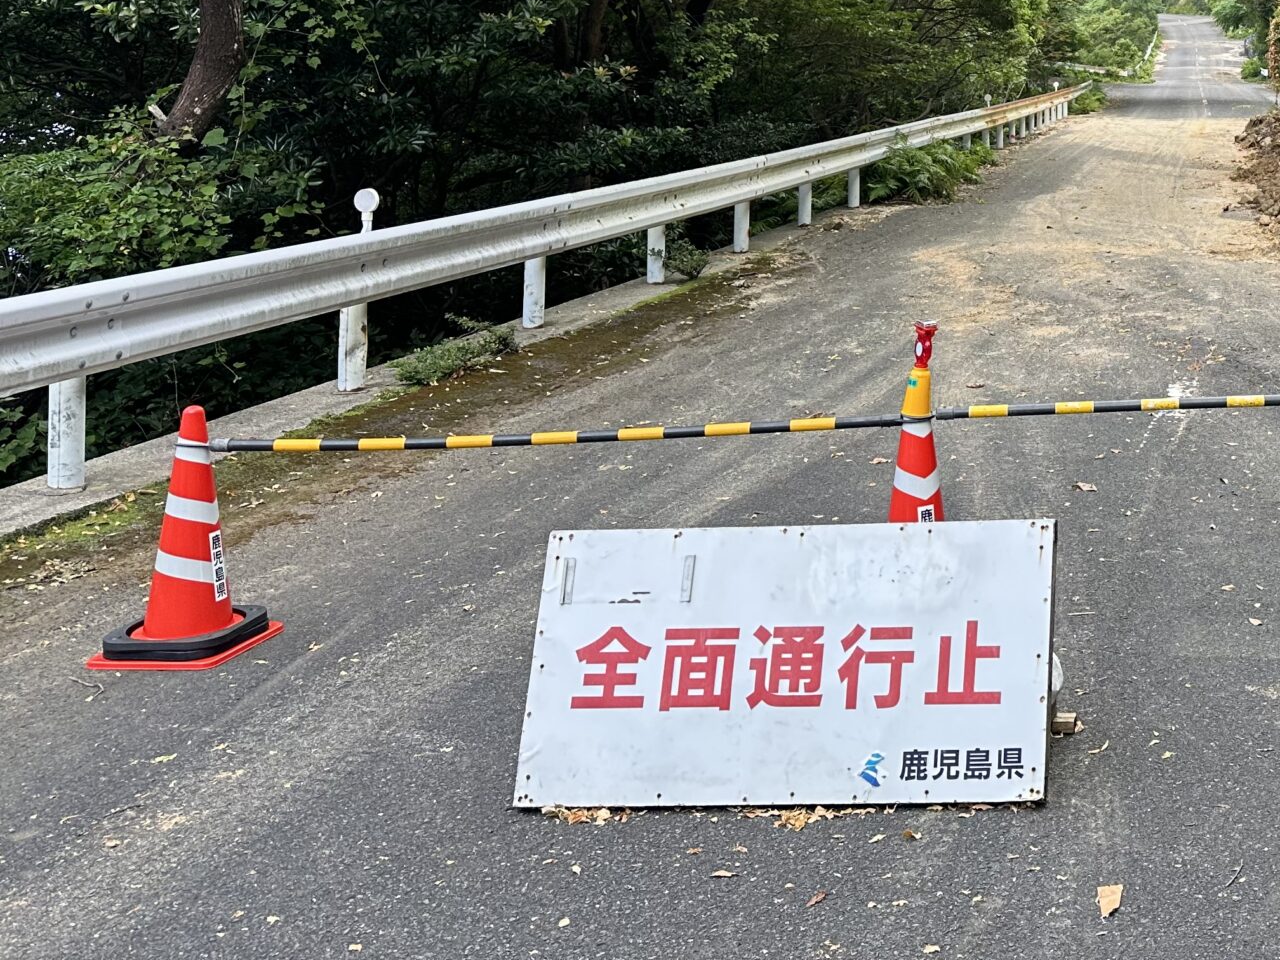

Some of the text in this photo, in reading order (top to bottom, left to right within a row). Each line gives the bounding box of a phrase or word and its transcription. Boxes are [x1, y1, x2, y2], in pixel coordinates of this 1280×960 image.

[211, 534, 227, 598] 鹿児島県
[570, 620, 1002, 712] 全面通行止
[899, 747, 1025, 781] 鹿児島県
